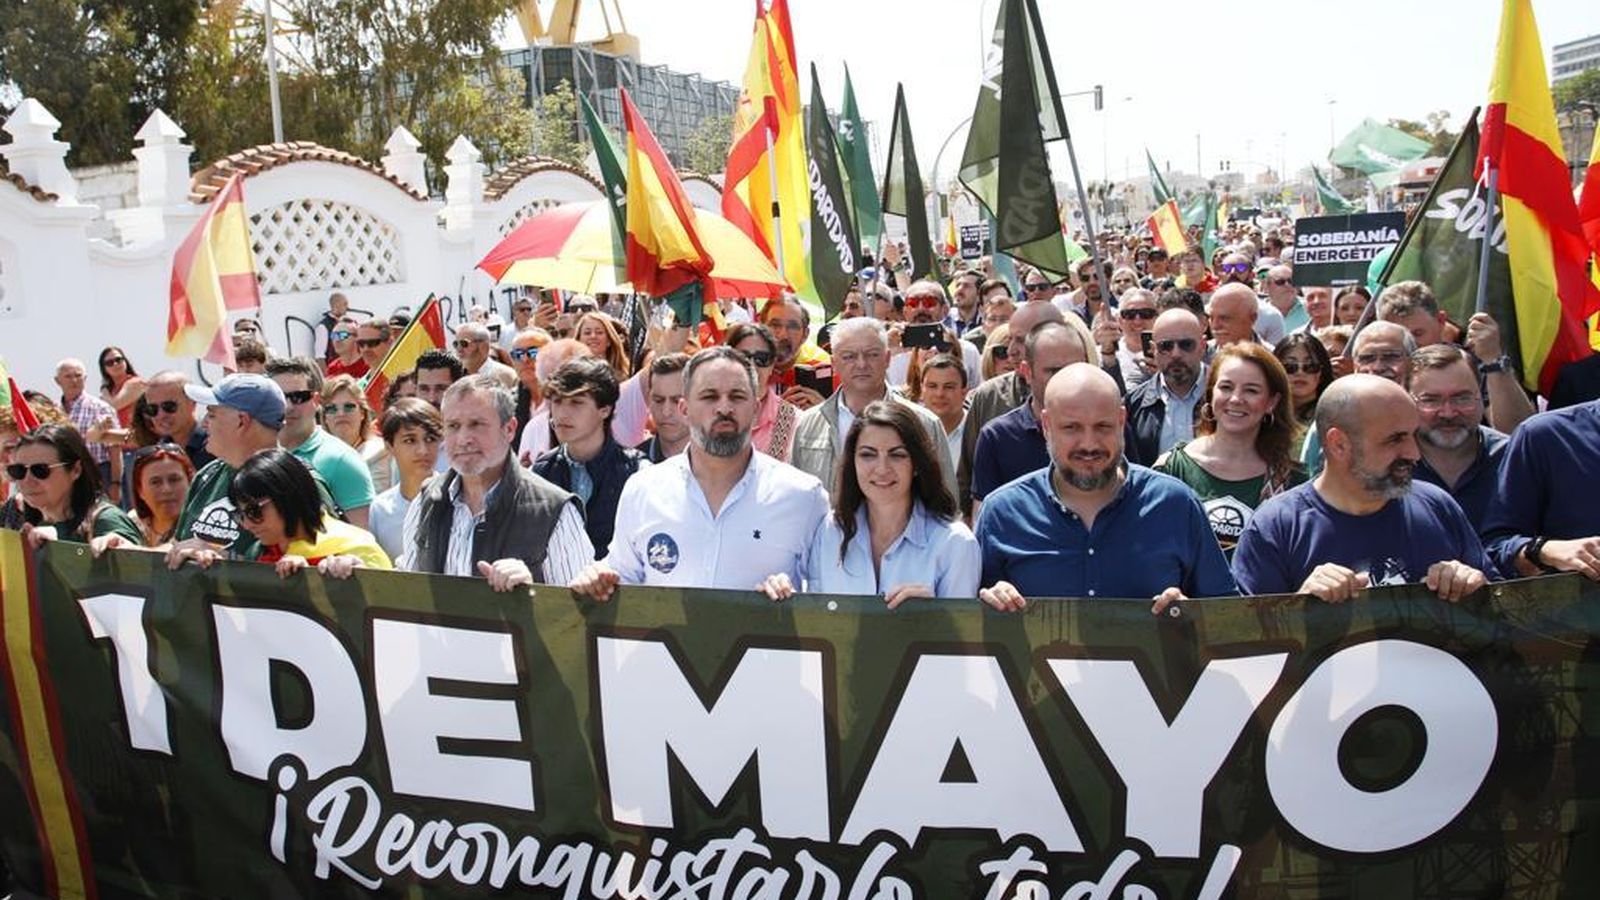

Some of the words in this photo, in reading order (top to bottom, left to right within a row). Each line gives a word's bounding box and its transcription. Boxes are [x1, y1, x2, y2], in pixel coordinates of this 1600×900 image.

[1298, 226, 1400, 246] SOBERANÍA
[78, 594, 172, 756] 1
[213, 604, 536, 812] DE
[597, 636, 1498, 858] MAYO
